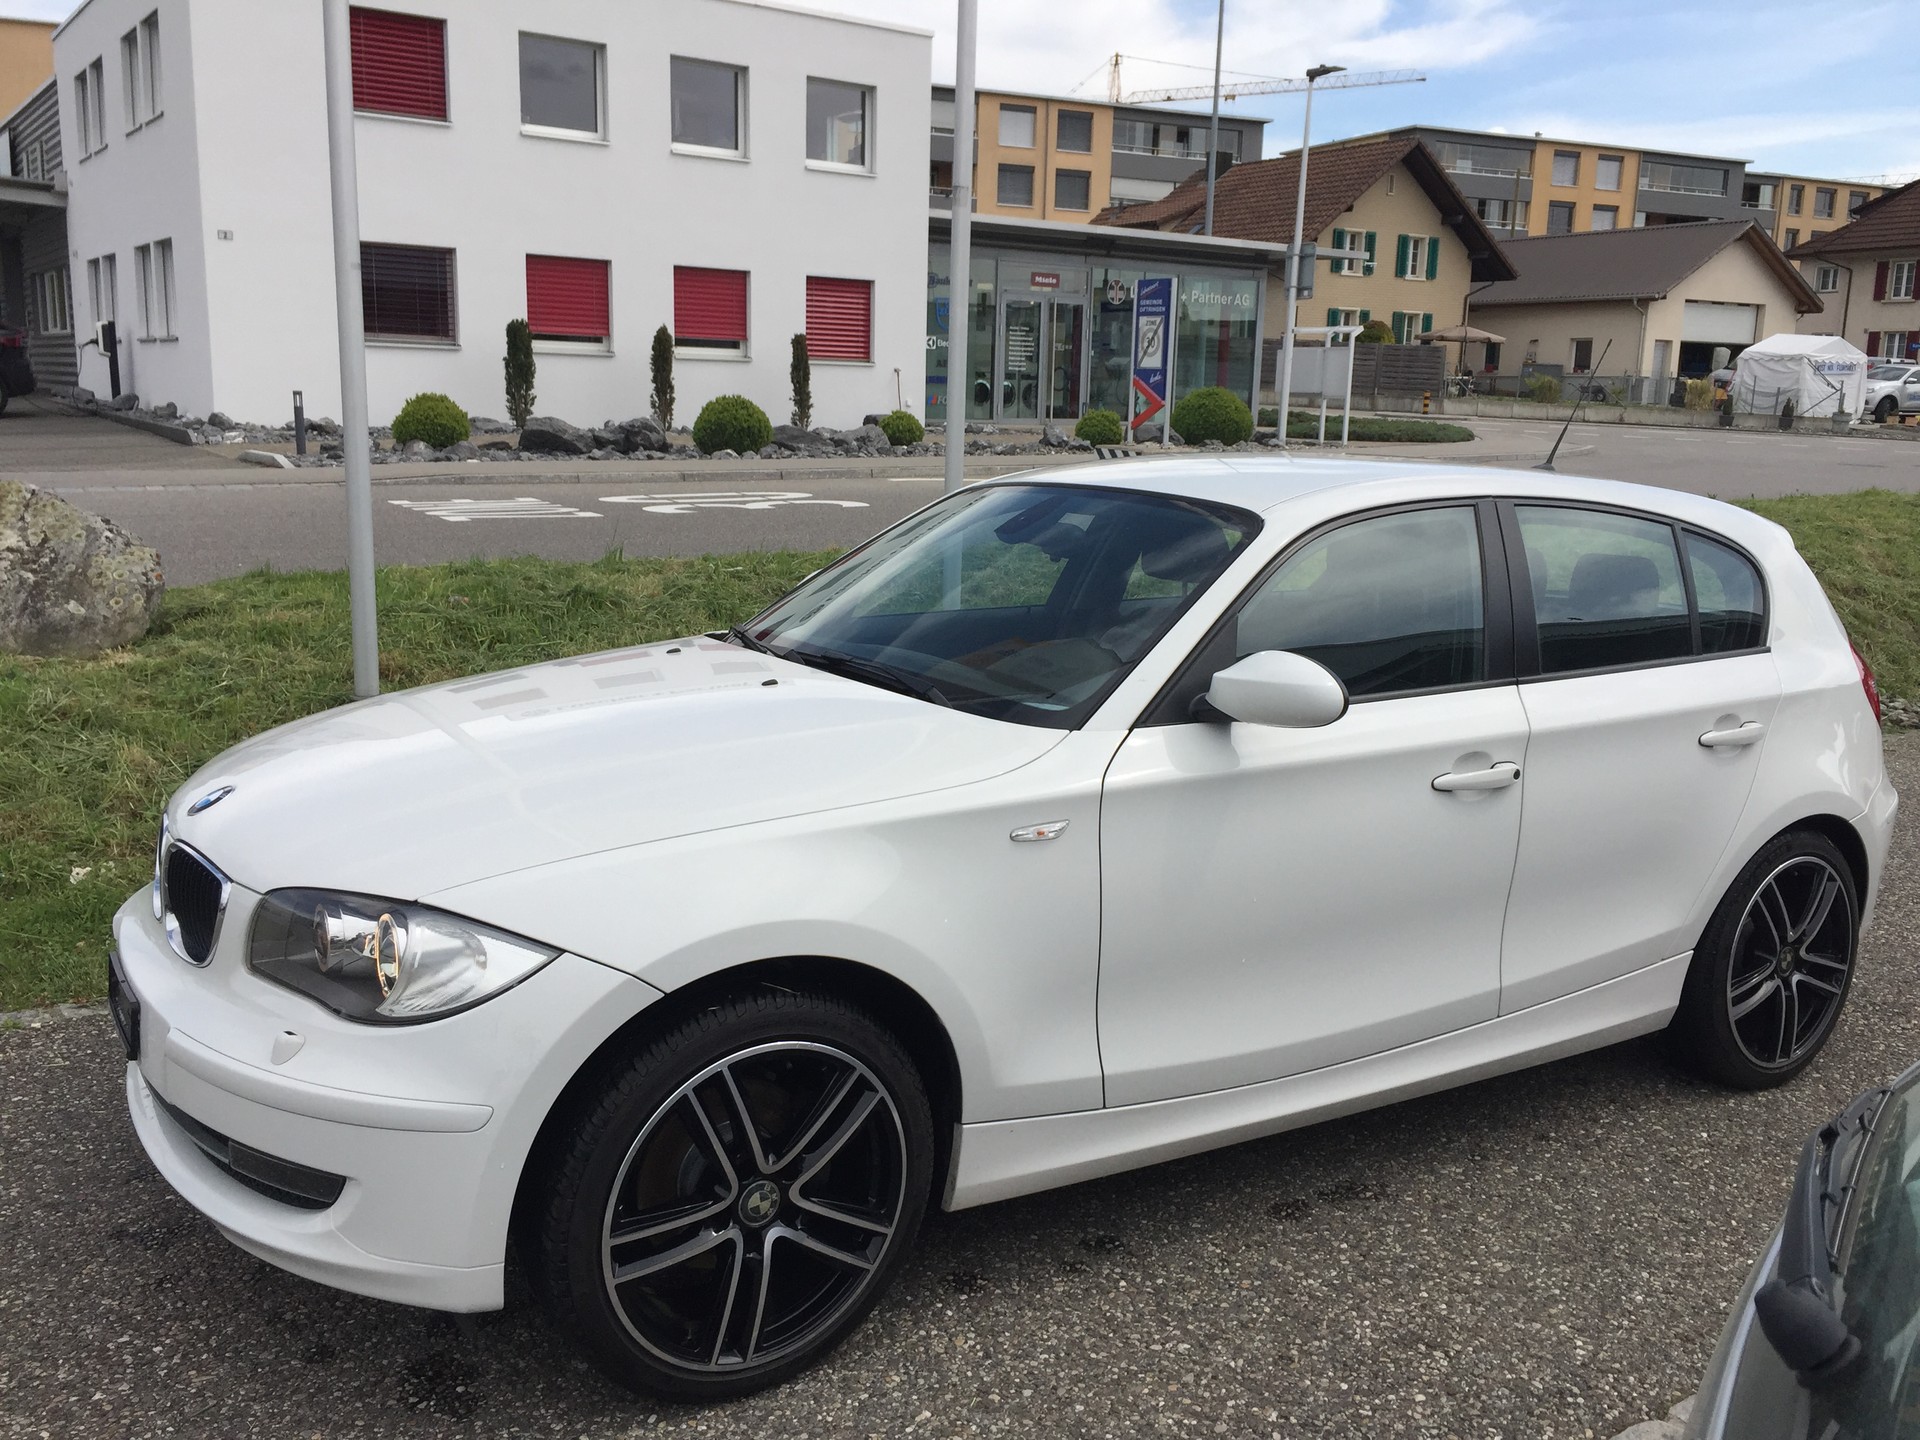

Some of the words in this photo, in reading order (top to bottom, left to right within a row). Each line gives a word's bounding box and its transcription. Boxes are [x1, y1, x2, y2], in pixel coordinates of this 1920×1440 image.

[1034, 275, 1057, 284] Miele
[1191, 290, 1233, 305] Partner
[1234, 293, 1250, 306] AG
[1145, 336, 1156, 349] 30
